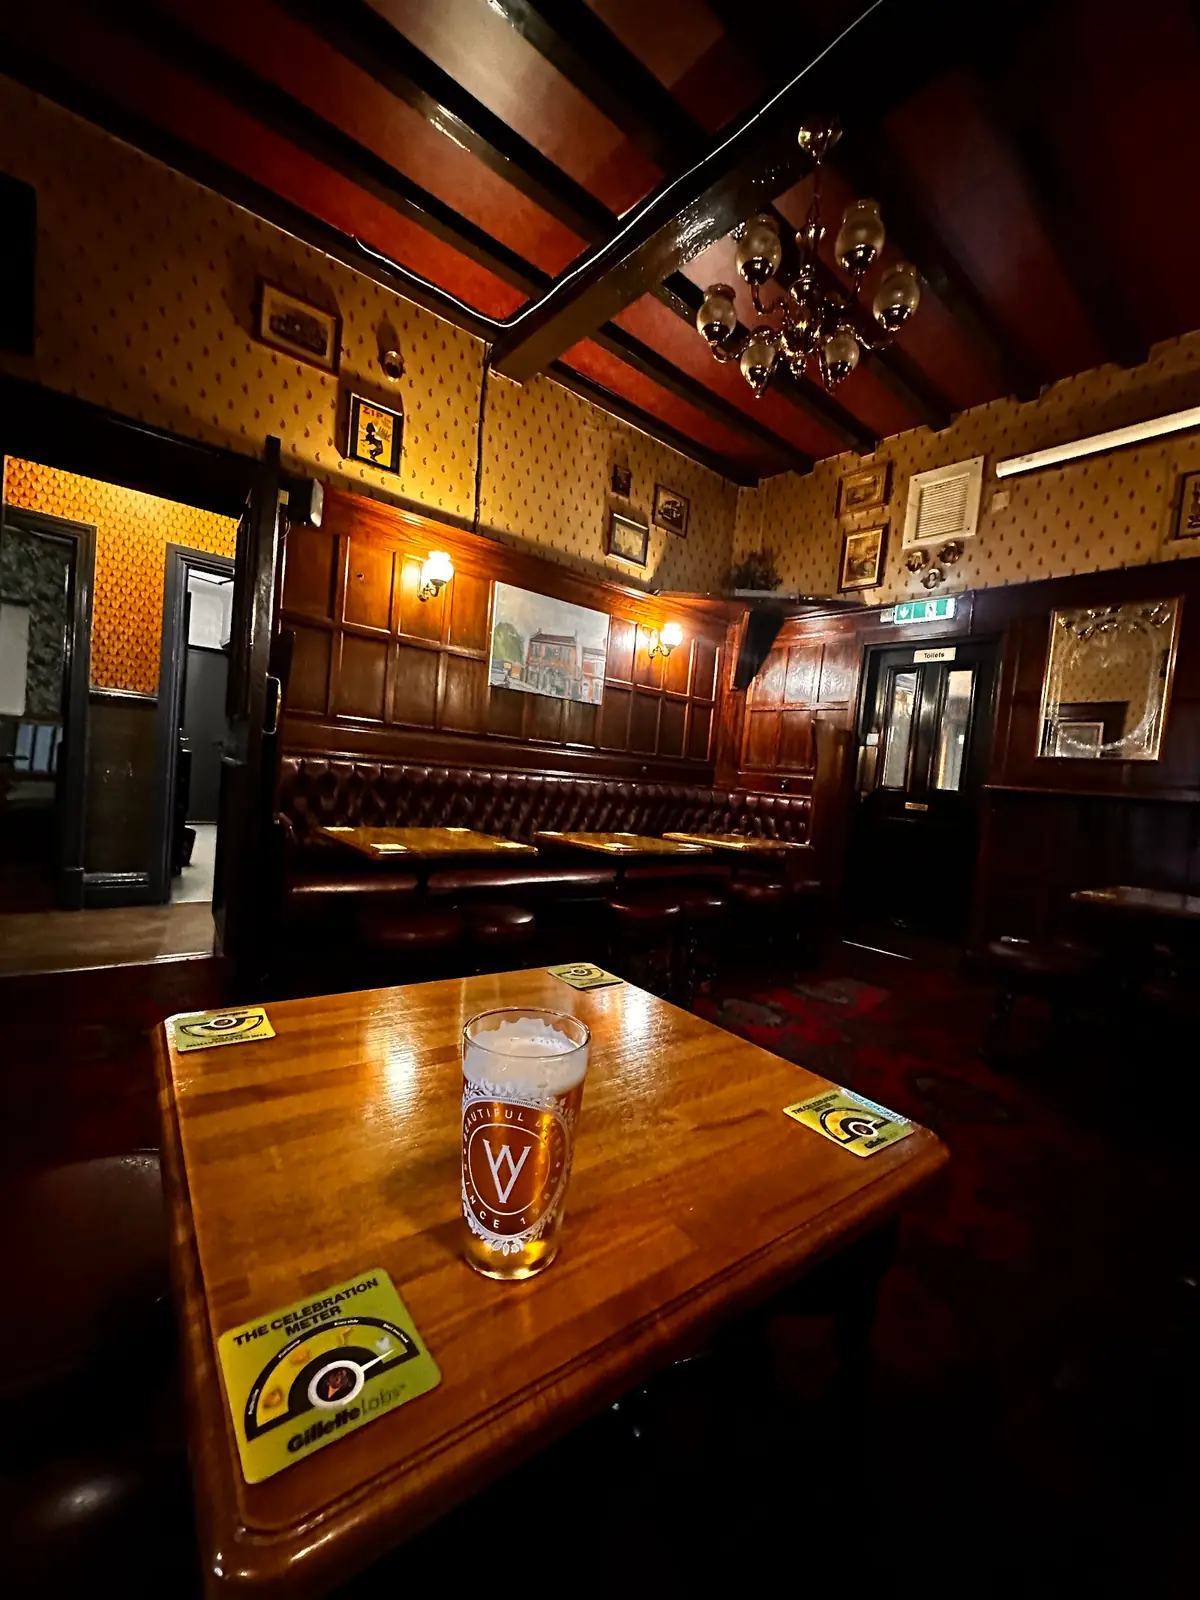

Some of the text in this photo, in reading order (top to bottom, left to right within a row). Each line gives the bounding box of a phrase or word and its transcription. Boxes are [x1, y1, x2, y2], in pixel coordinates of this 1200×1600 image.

[232, 1278, 379, 1346] THE CELEBRATION
[285, 1305, 342, 1337] METER
